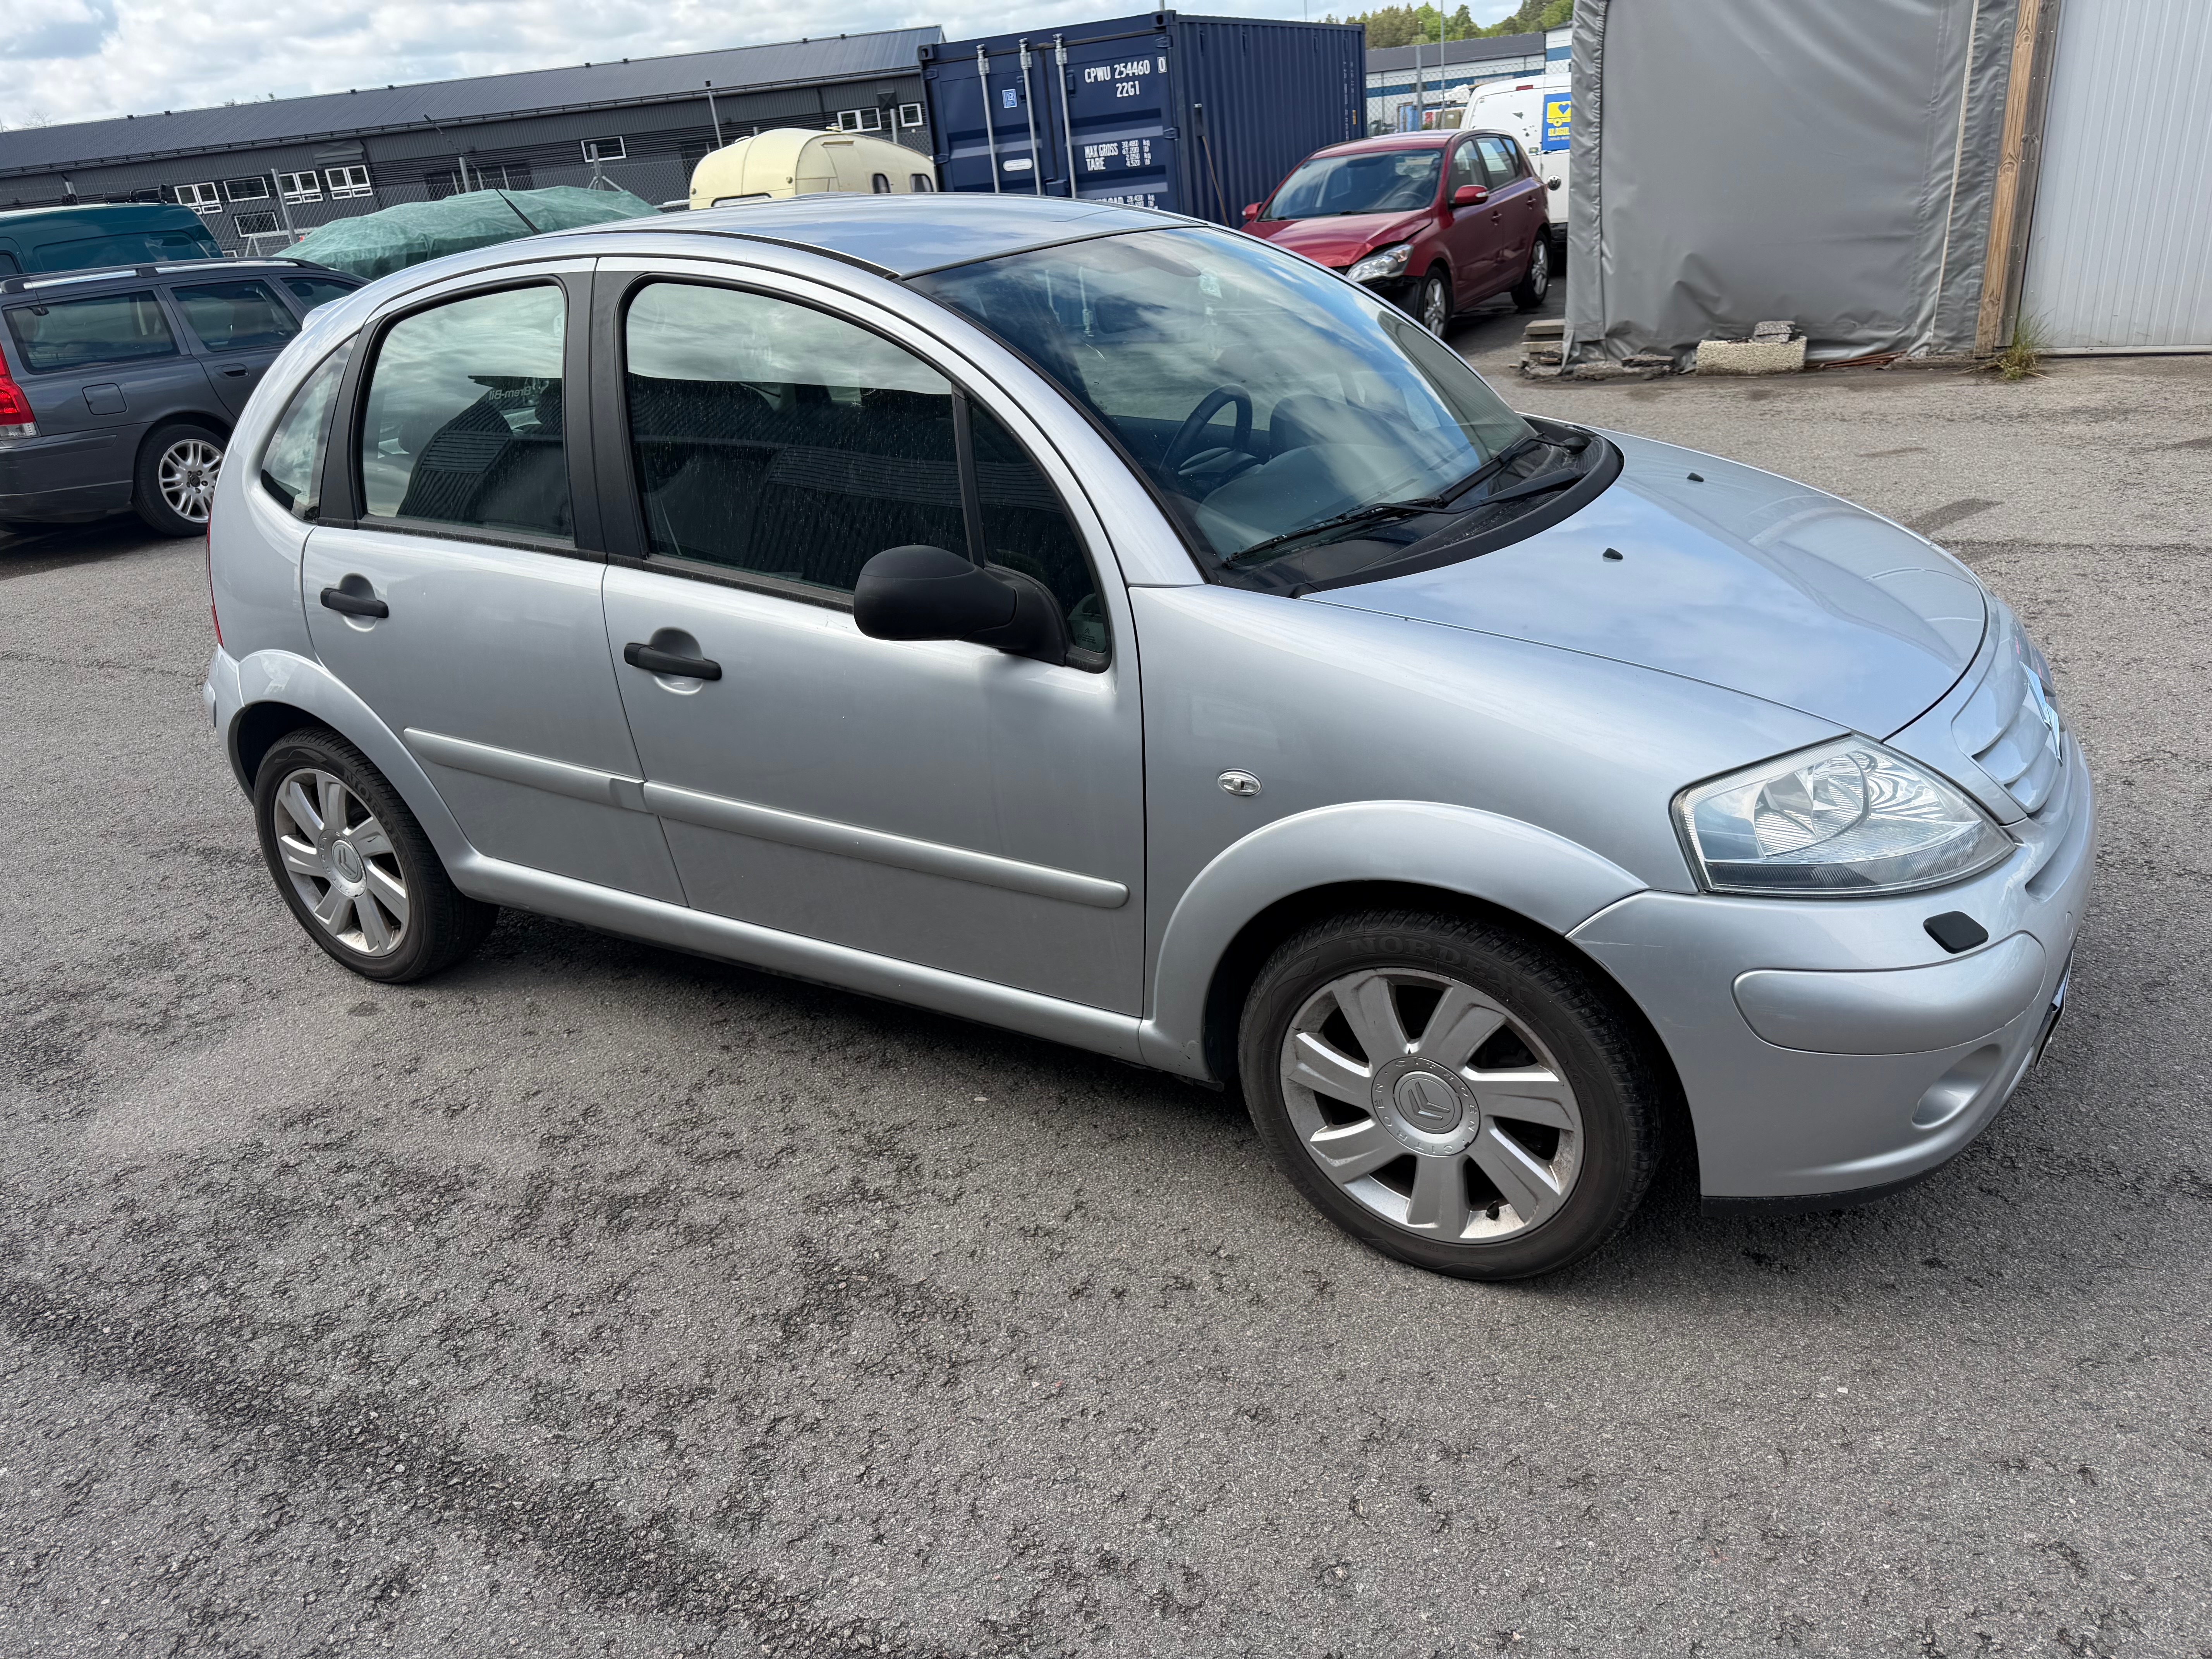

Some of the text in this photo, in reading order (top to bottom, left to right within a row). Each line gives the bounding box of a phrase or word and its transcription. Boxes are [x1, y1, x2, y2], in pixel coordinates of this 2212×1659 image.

[1085, 58, 1166, 83] CPWU 254460 0
[1116, 81, 1140, 97] 22G1
[1085, 157, 1106, 171] TARE
[1375, 1083, 1453, 1154] CITROËN
